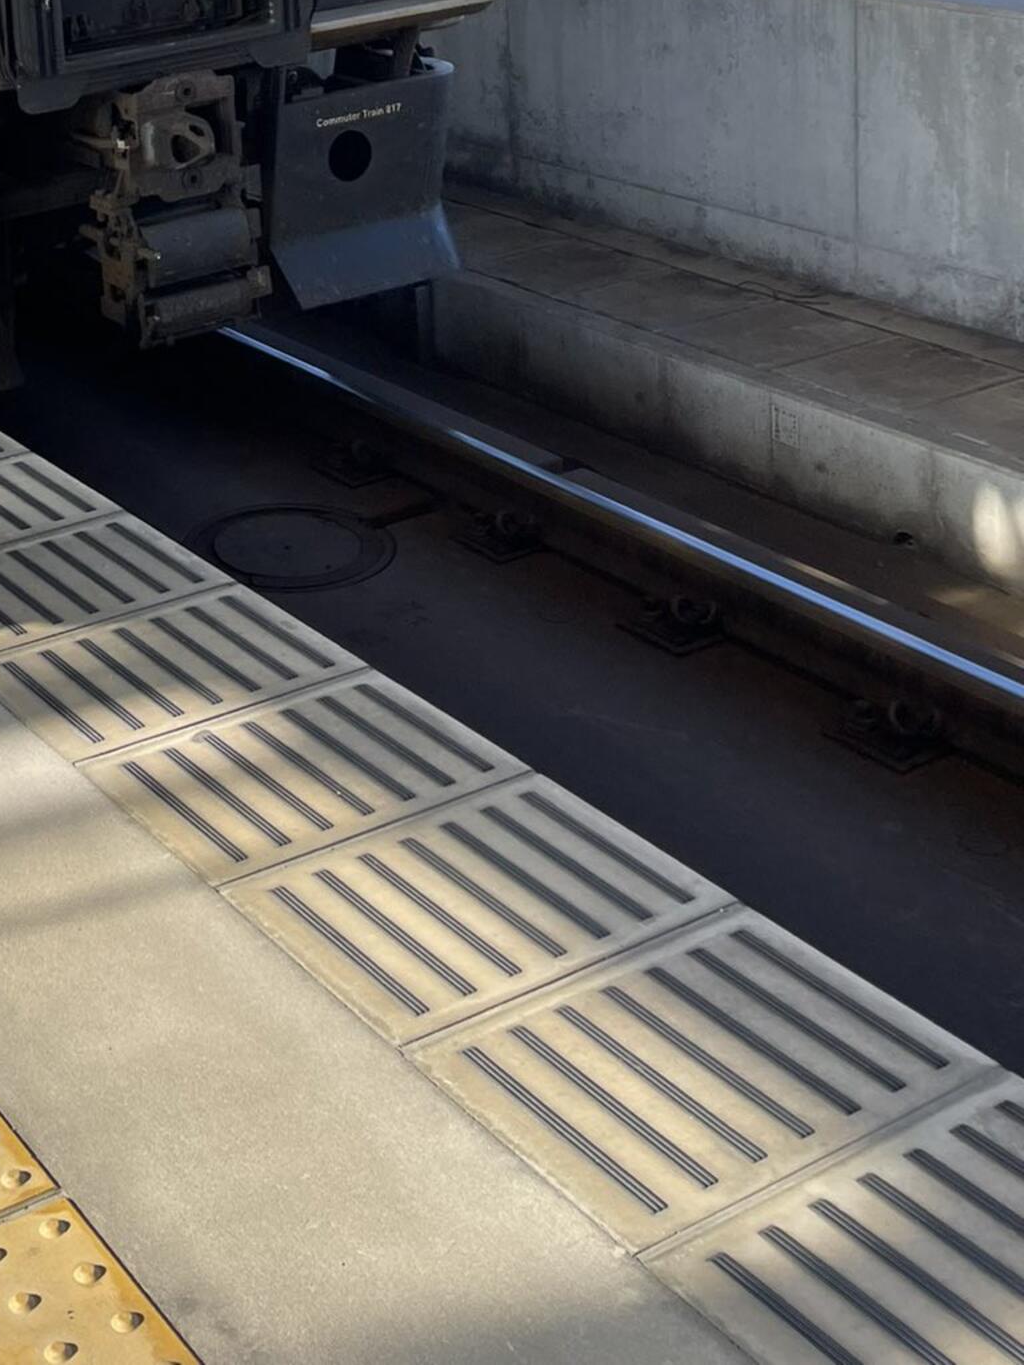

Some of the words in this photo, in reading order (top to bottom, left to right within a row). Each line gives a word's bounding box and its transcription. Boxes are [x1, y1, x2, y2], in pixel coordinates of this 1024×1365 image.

[316, 112, 362, 128] Commuter
[362, 108, 385, 120] Train
[385, 102, 402, 114] 817
